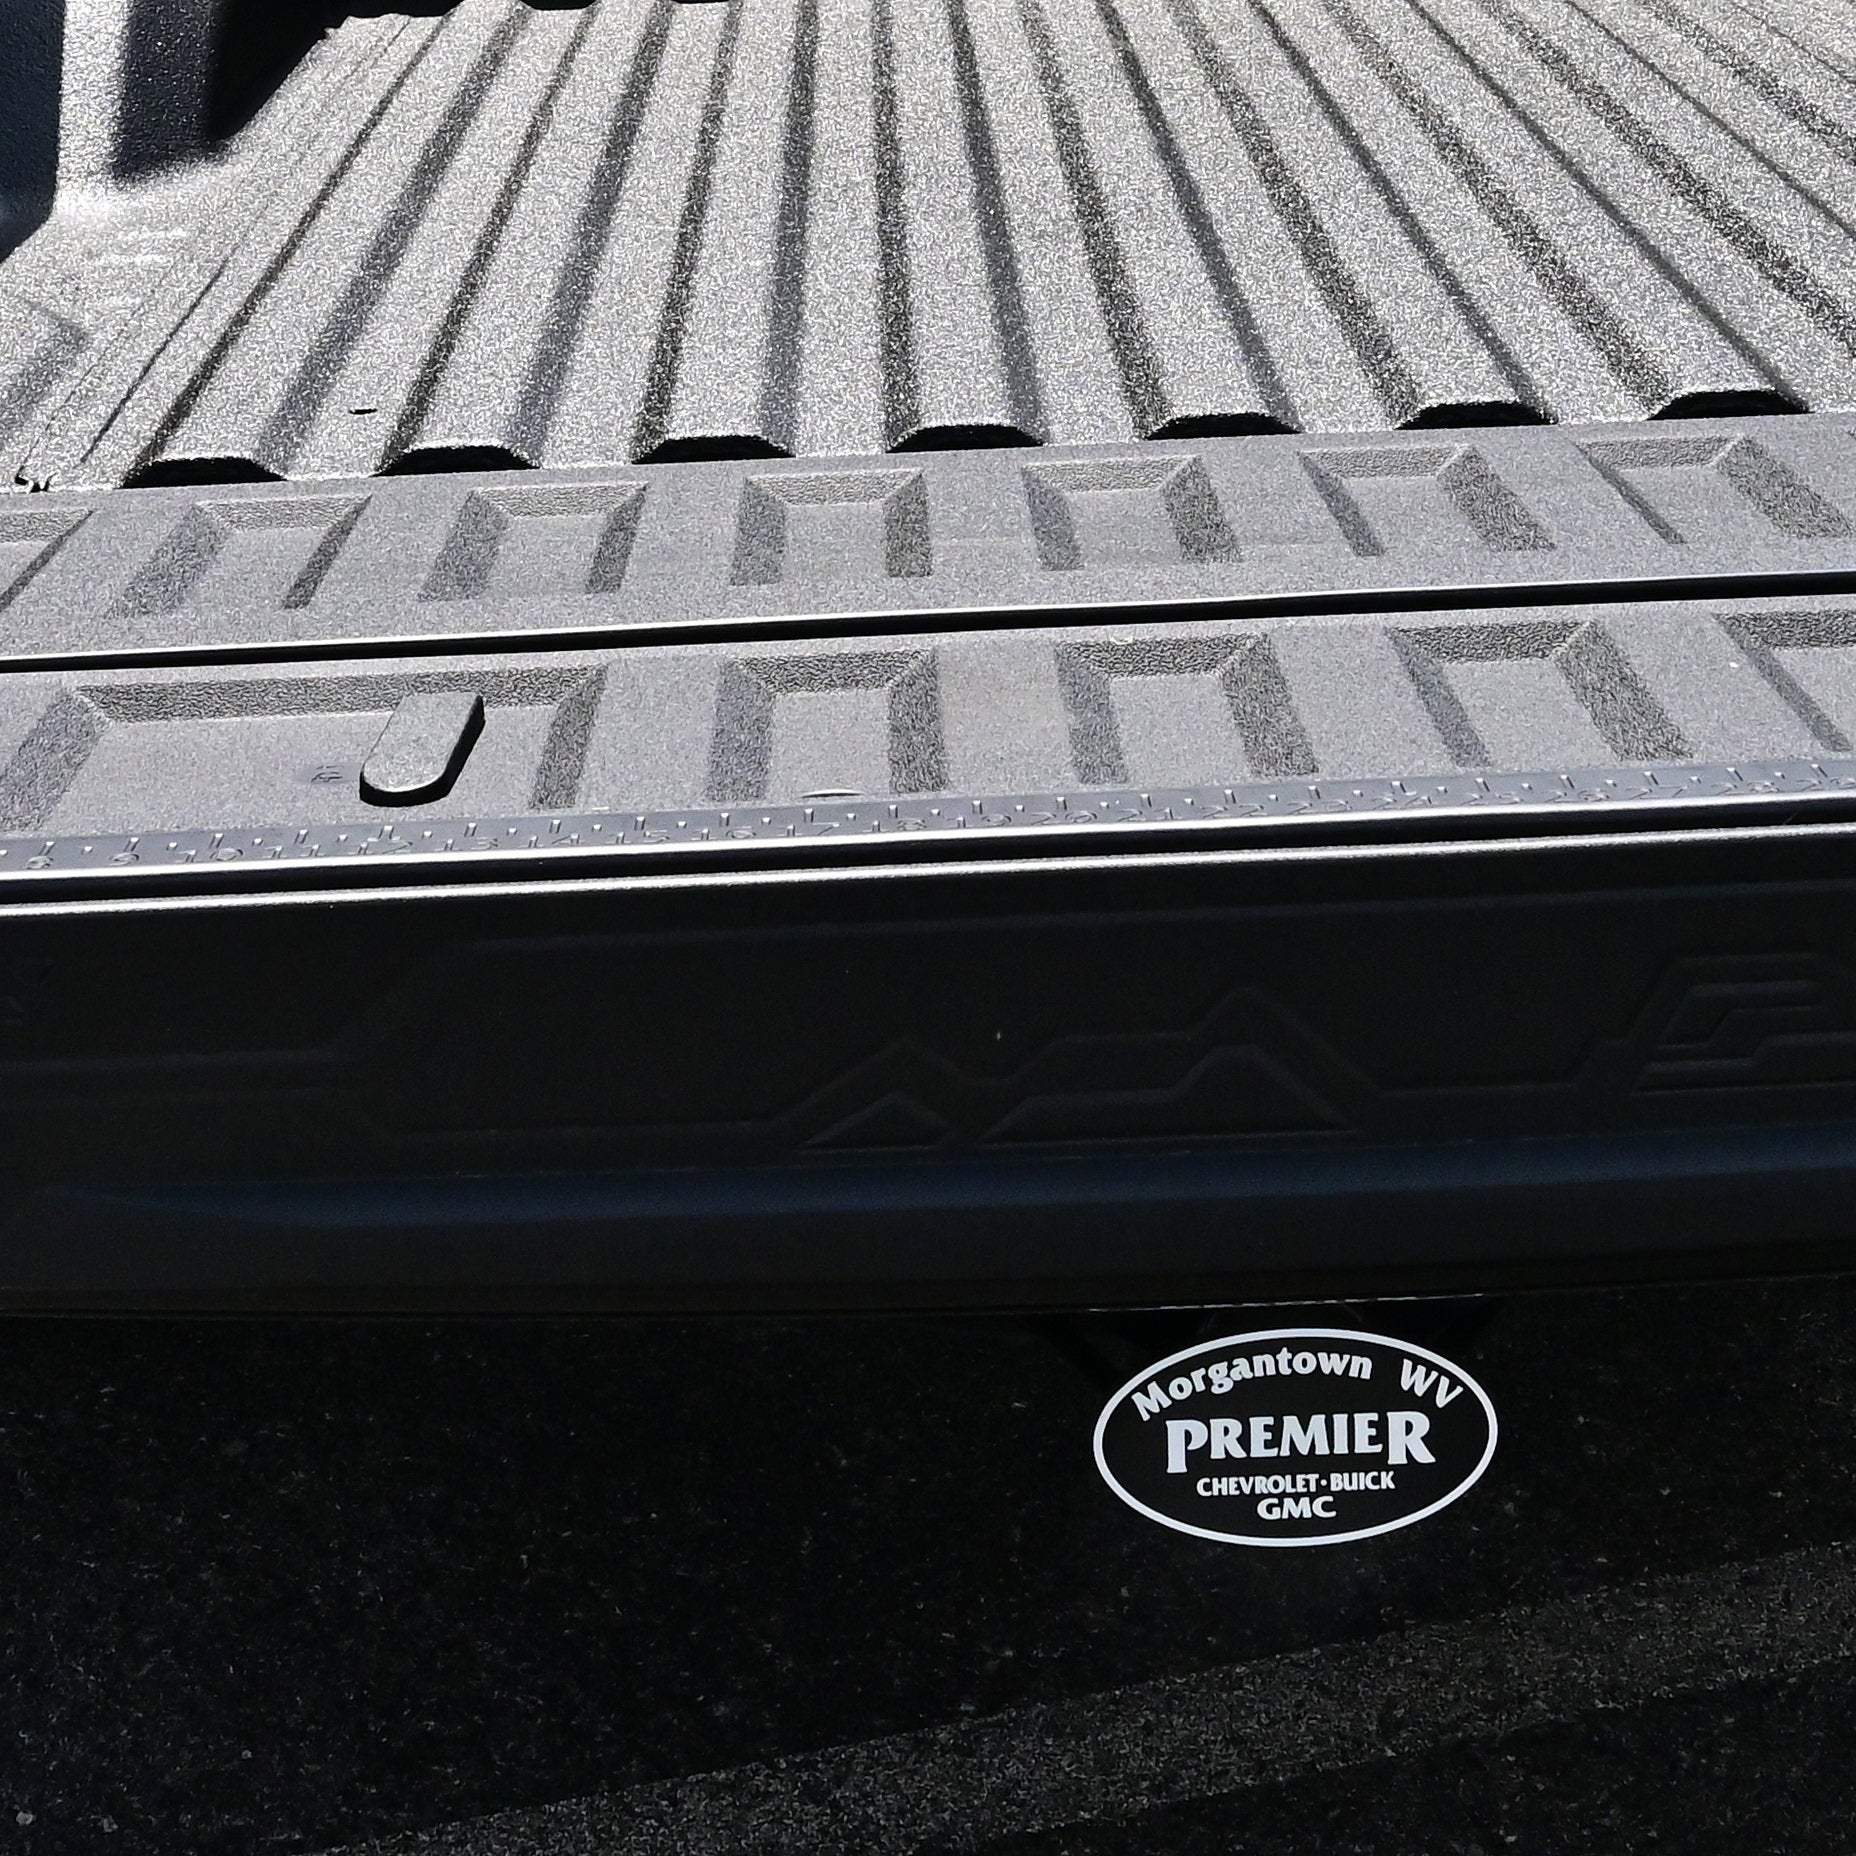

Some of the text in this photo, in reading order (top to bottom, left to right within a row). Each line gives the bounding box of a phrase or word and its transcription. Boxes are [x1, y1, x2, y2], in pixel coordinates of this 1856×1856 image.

[1130, 1346, 1464, 1422] Morgantown WV
[1165, 1410, 1436, 1474] PREMIER
[1256, 1496, 1337, 1520] GMC
